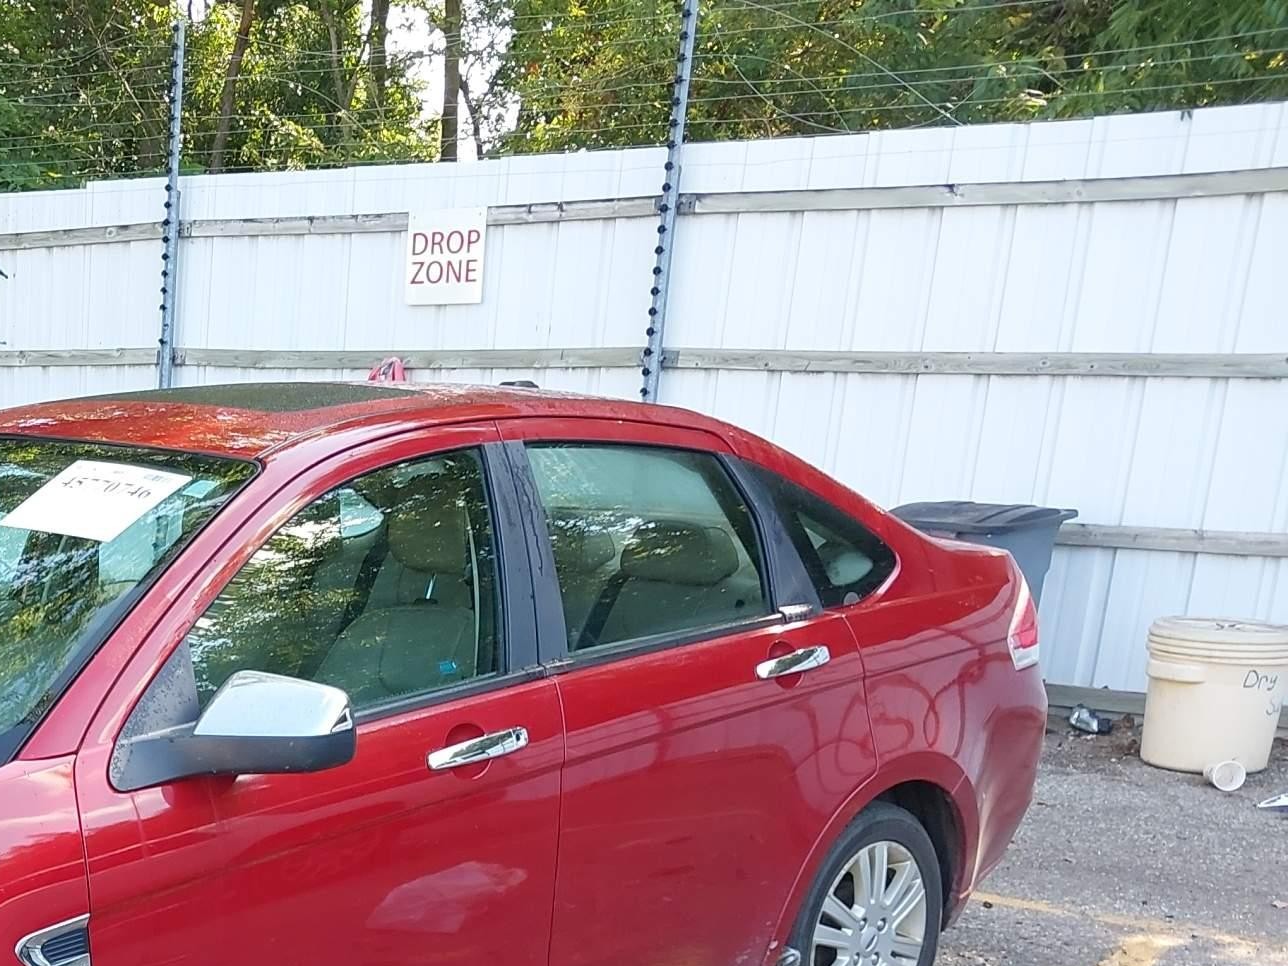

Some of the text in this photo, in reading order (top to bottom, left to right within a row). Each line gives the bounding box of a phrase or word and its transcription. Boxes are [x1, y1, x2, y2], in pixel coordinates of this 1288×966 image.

[411, 229, 481, 256] DROP
[410, 259, 478, 285] ZONE
[1242, 669, 1279, 692] Dry
